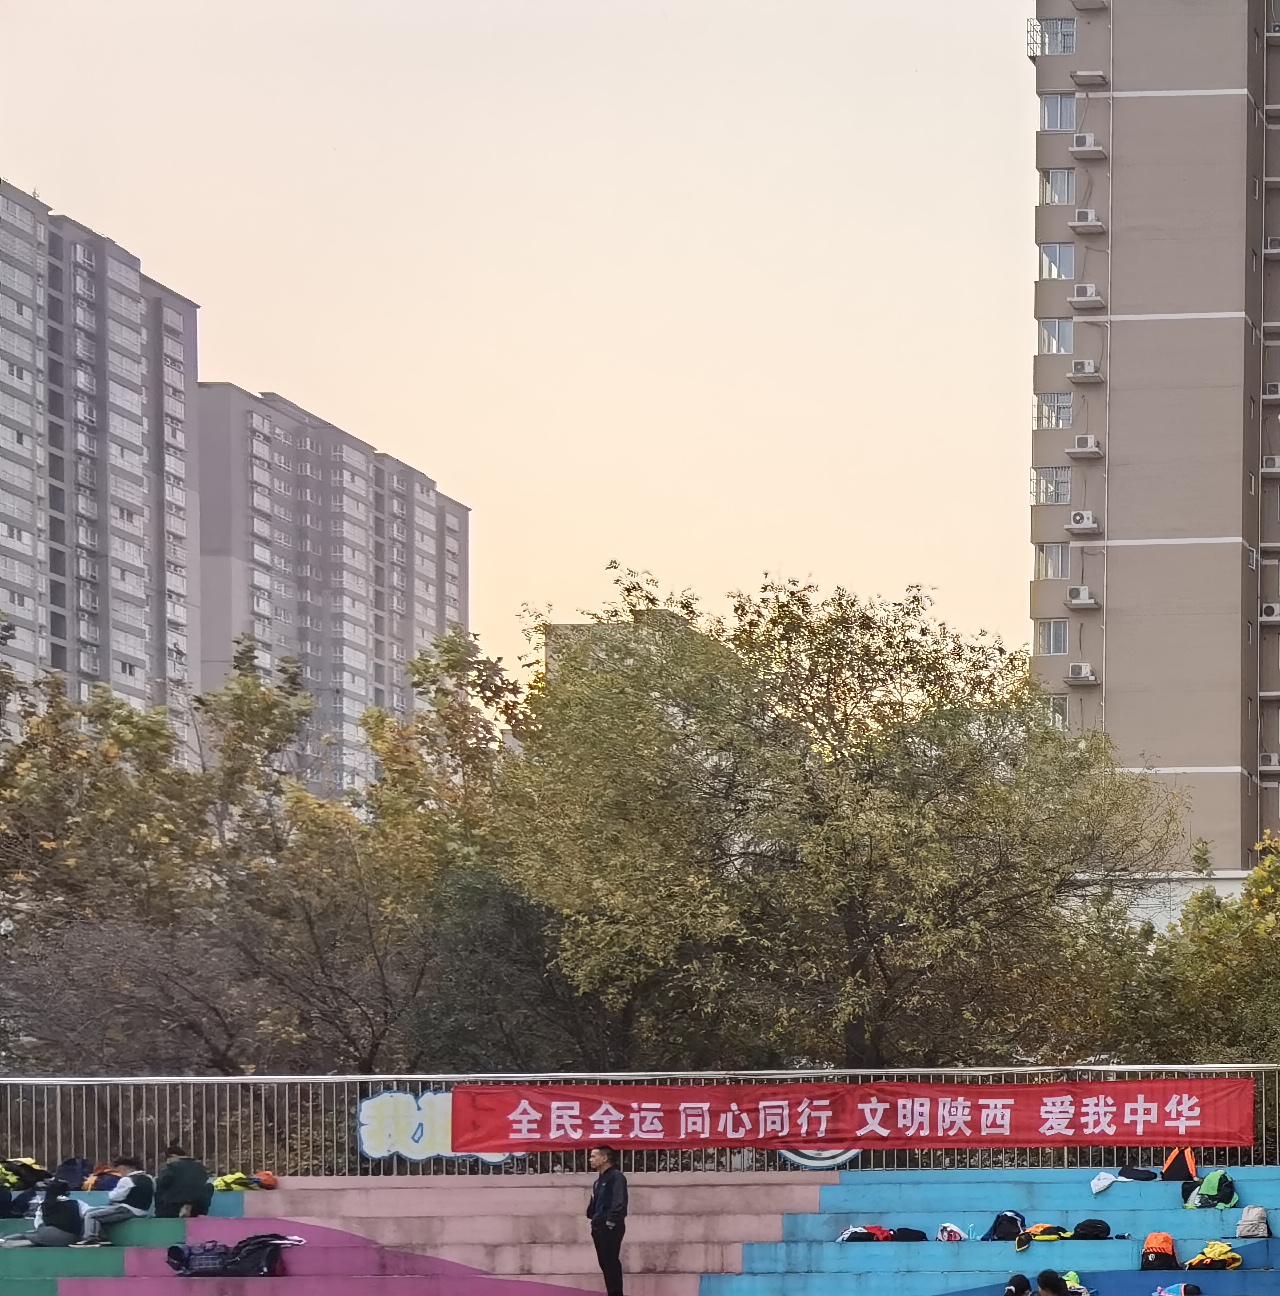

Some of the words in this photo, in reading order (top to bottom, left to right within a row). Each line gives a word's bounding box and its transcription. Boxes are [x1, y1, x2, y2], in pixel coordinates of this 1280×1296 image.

[507, 1099, 665, 1140] 全民全运
[679, 1097, 834, 1140] 同心同行
[855, 1096, 1016, 1138] 文明陕西
[1038, 1093, 1202, 1137] 爱我中华
